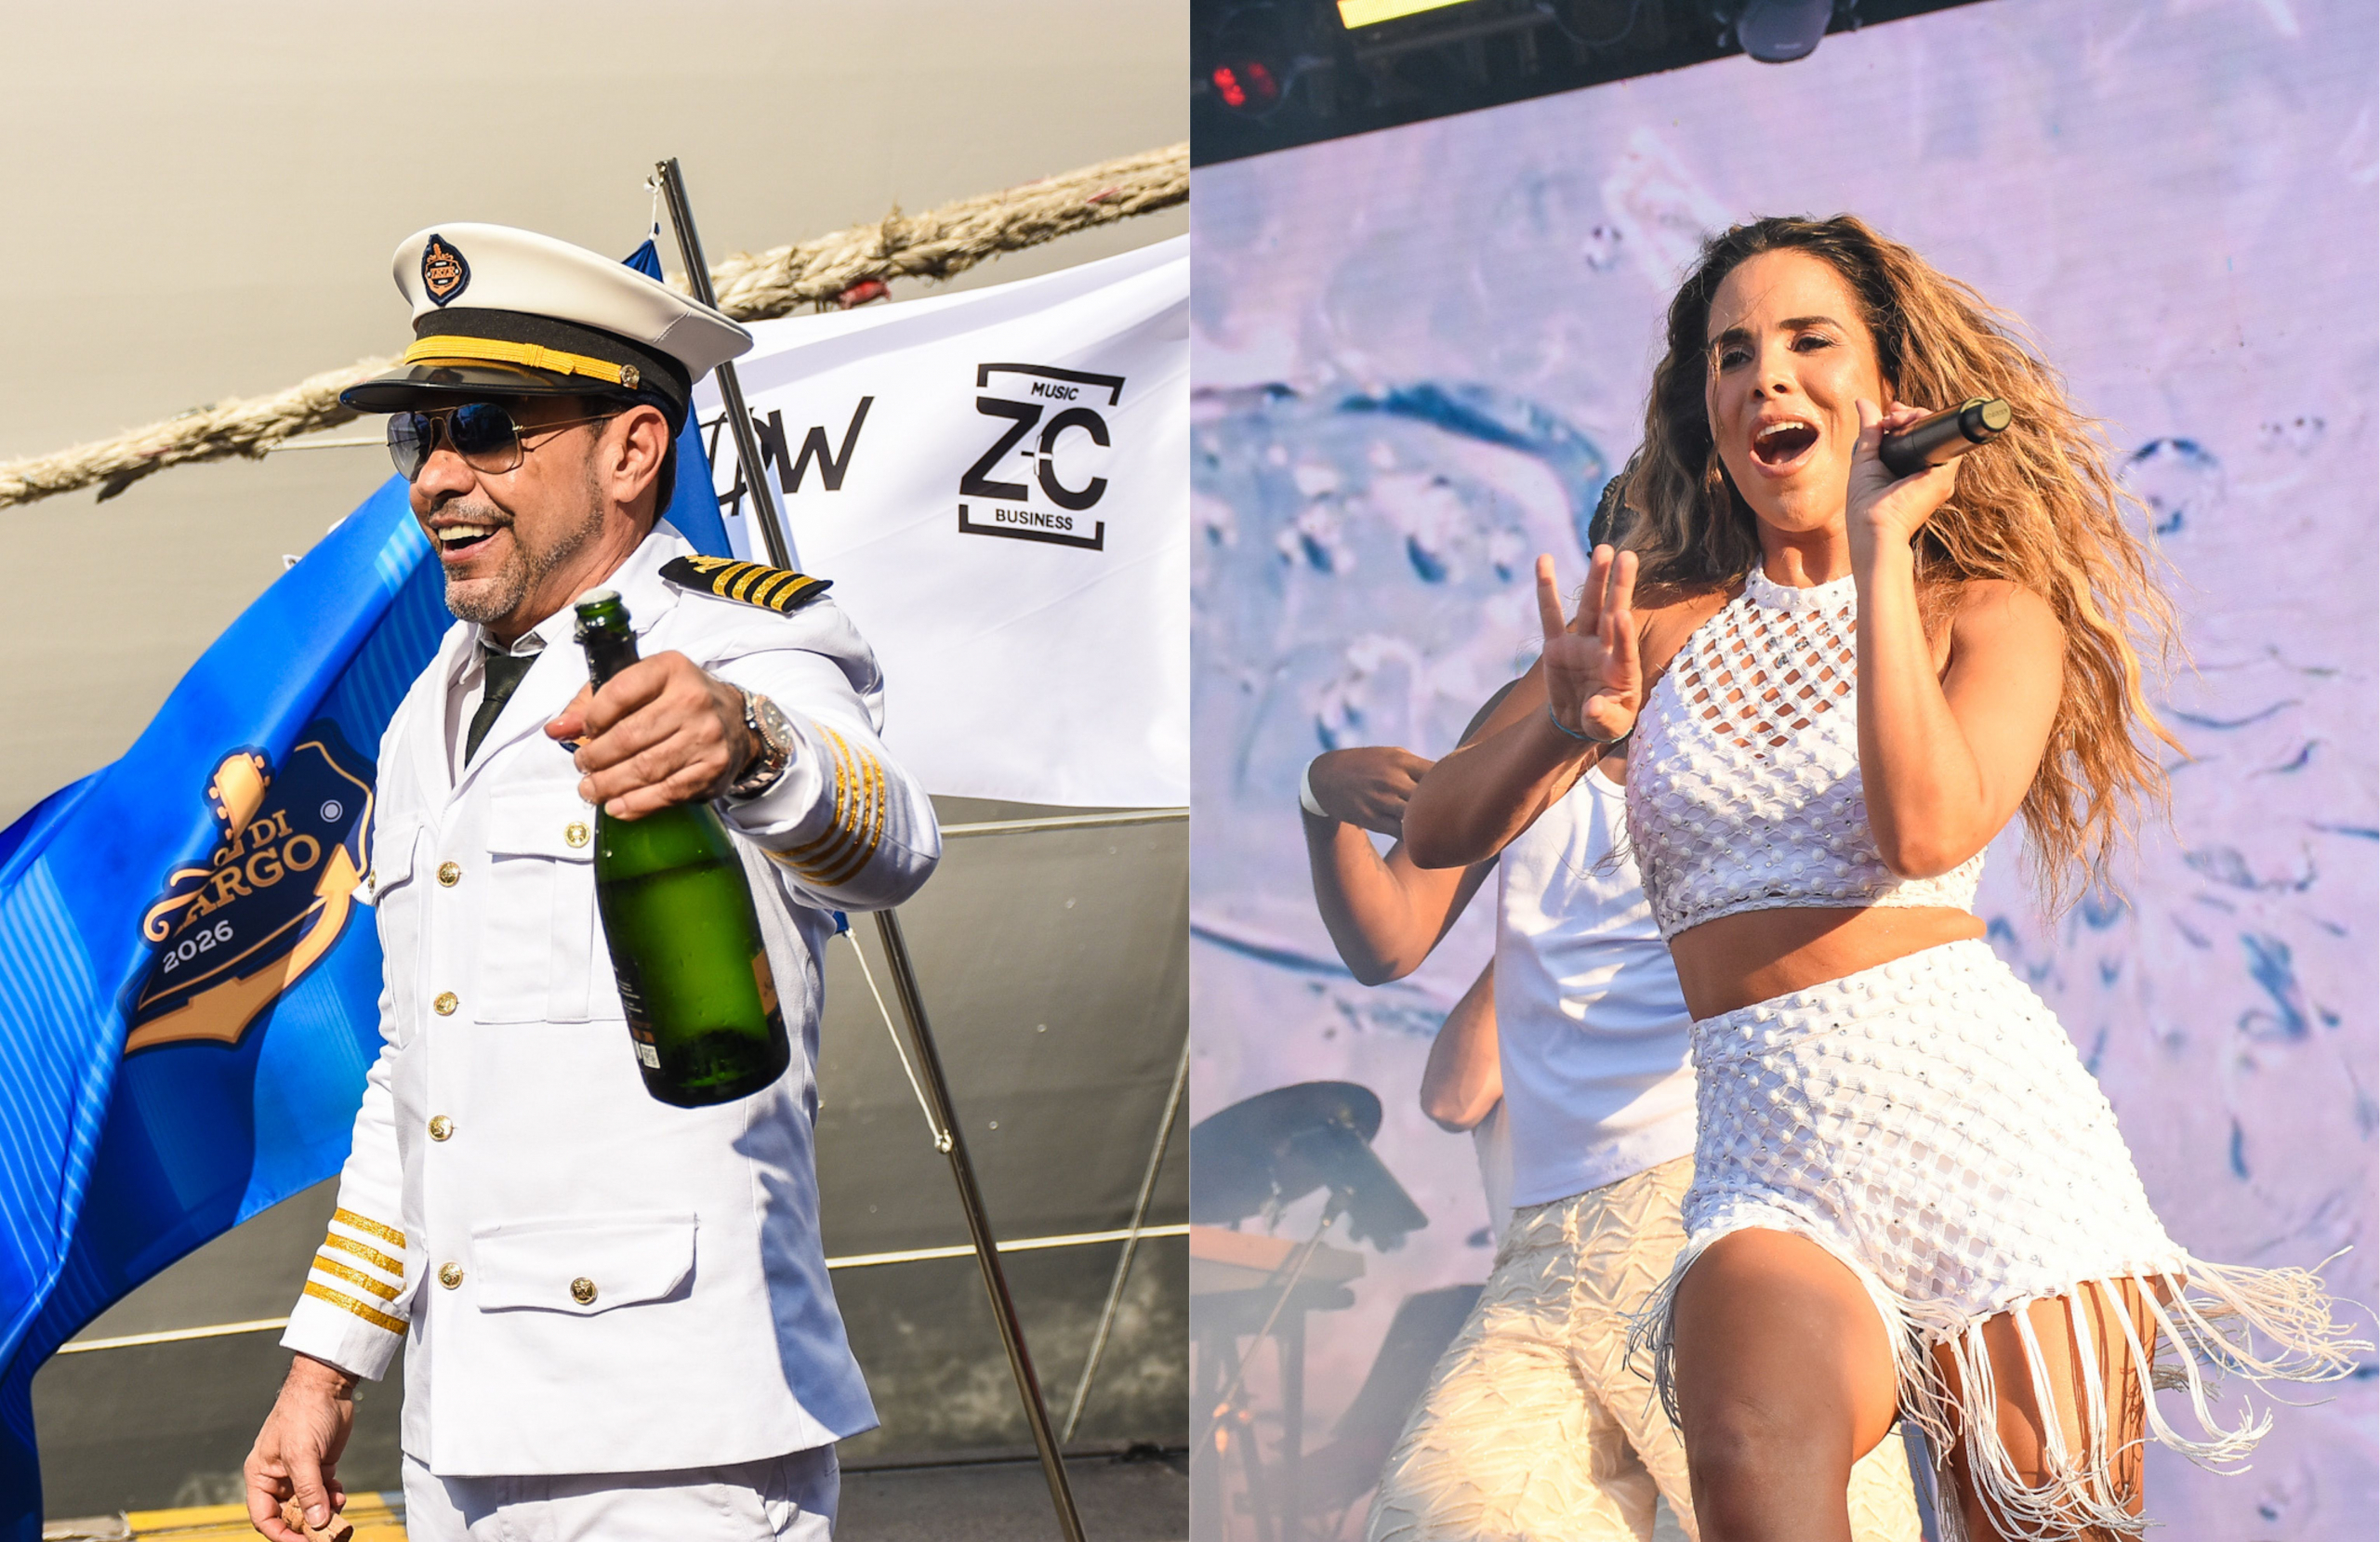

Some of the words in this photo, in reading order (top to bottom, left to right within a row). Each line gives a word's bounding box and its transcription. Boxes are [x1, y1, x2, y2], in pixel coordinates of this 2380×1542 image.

[1031, 381, 1079, 402] MUSIC
[959, 395, 1111, 511] ZC
[996, 507, 1074, 531] BUSINESS
[247, 809, 294, 850] DI
[173, 834, 322, 938] ARGO
[162, 919, 234, 974] 2026
